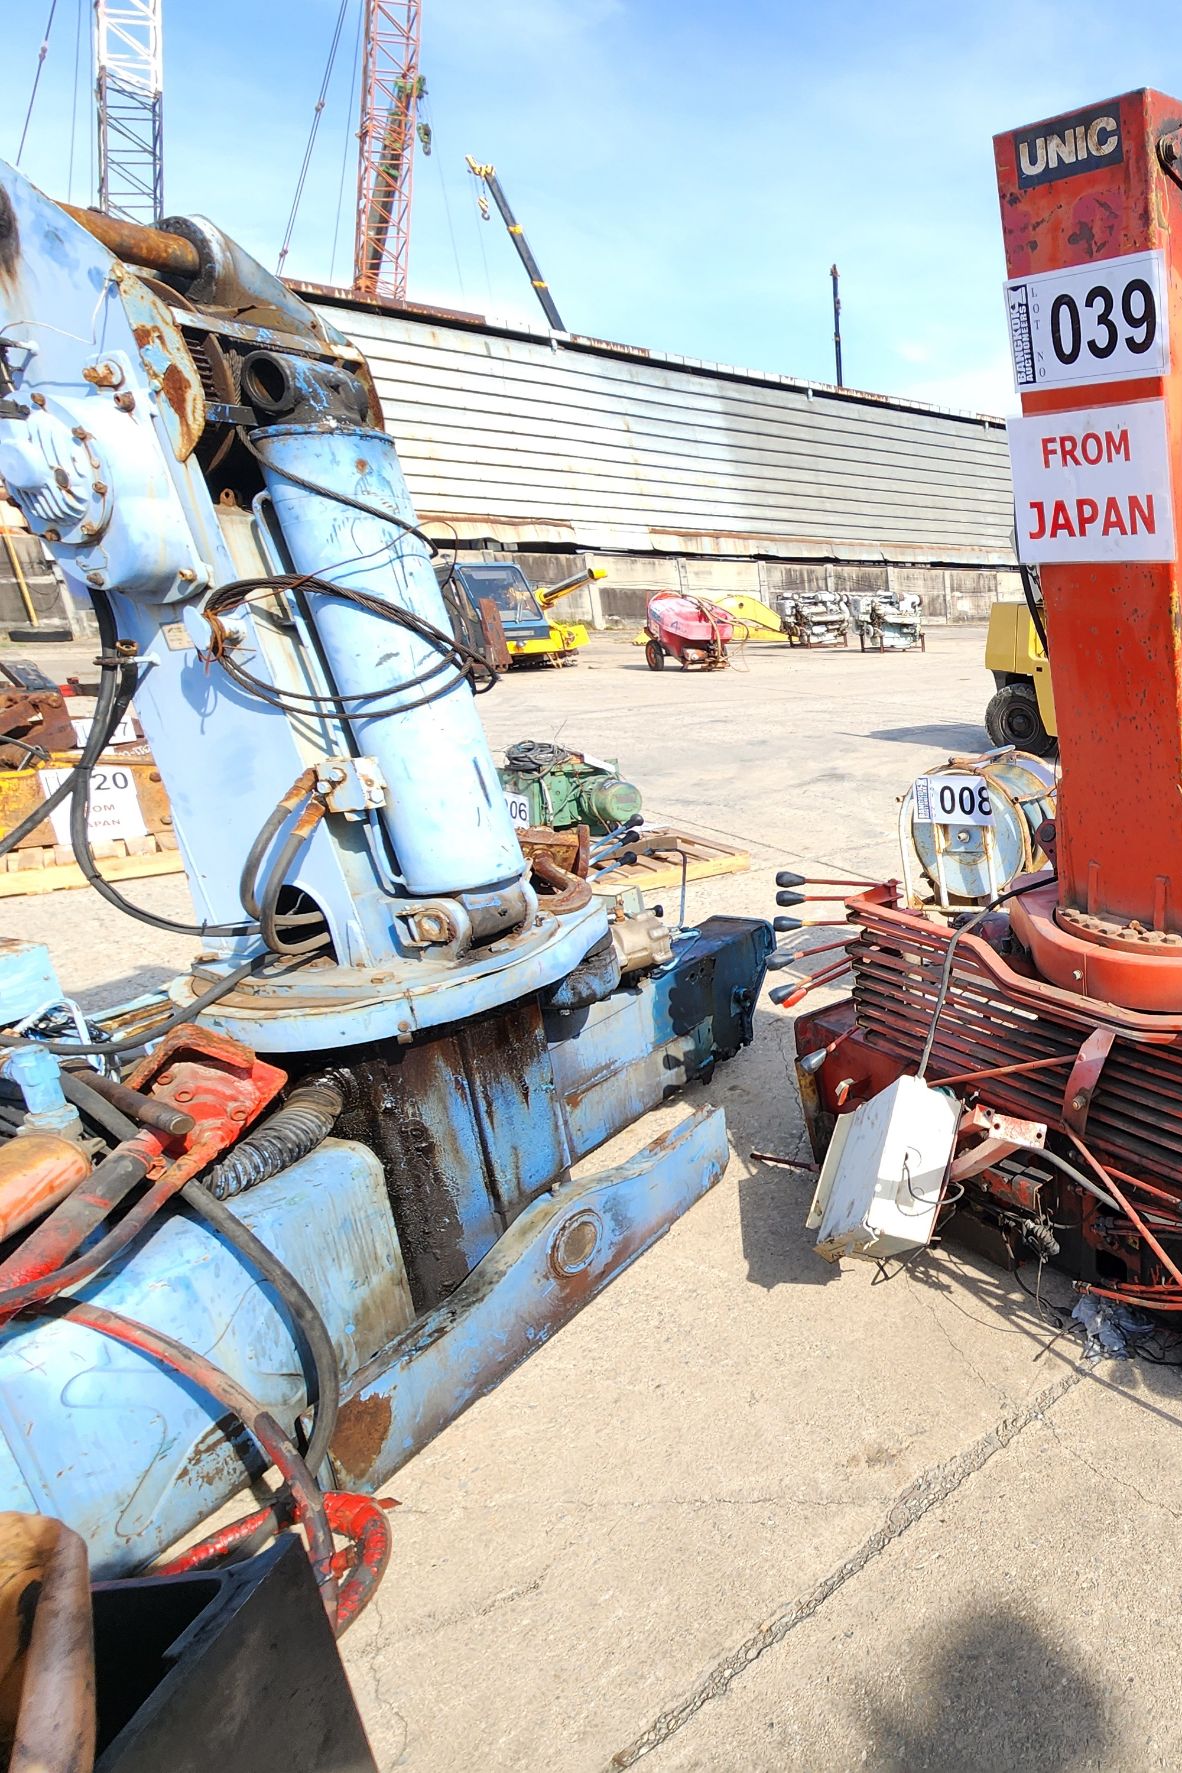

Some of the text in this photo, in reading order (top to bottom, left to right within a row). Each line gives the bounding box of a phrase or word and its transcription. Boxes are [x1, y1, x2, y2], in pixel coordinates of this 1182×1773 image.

[1019, 116, 1118, 176] UNIC
[1031, 287, 1041, 331] LOT
[1050, 278, 1157, 365] 039
[1010, 302, 1027, 383] BANGKOK
[1018, 305, 1034, 382] AUCTIONEERS
[1041, 429, 1131, 469] FROM
[1029, 494, 1156, 540] JAPAN
[91, 771, 129, 791] 20
[940, 785, 993, 816] 008
[504, 798, 527, 821] 06
